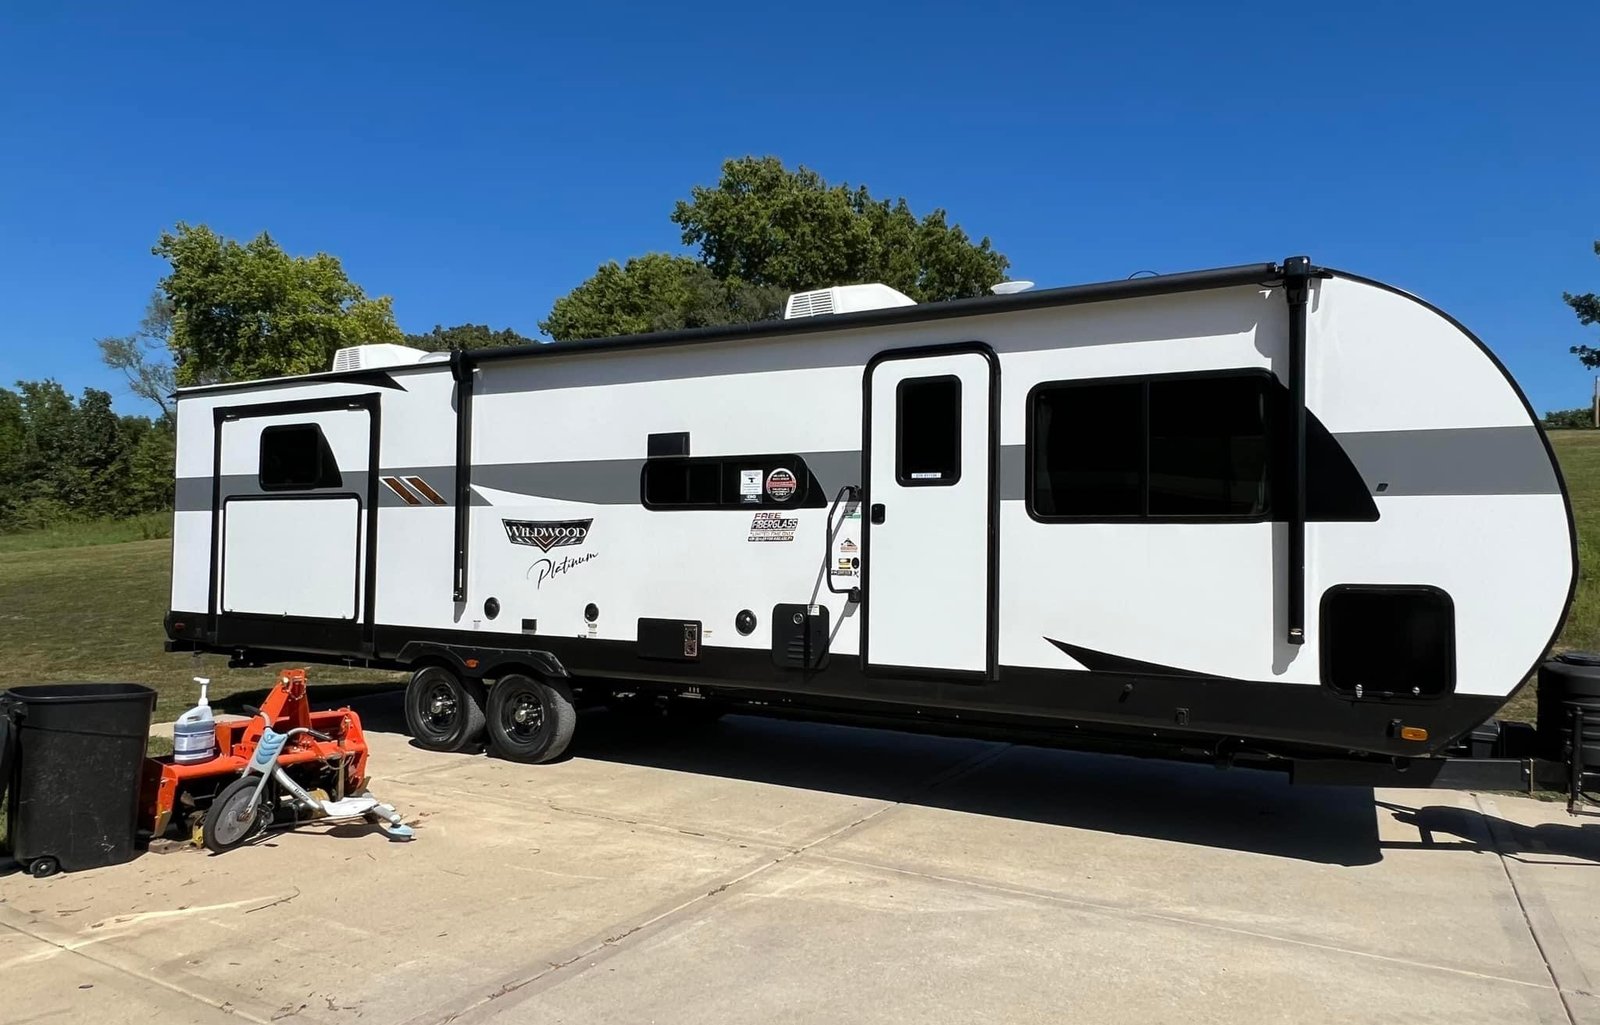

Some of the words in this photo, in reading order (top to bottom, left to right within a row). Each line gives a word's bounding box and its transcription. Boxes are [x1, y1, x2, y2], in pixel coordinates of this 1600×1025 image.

[751, 519, 798, 529] FIBERGLASS
[506, 525, 587, 538] WILDWOOD
[526, 552, 599, 590] Platinum
